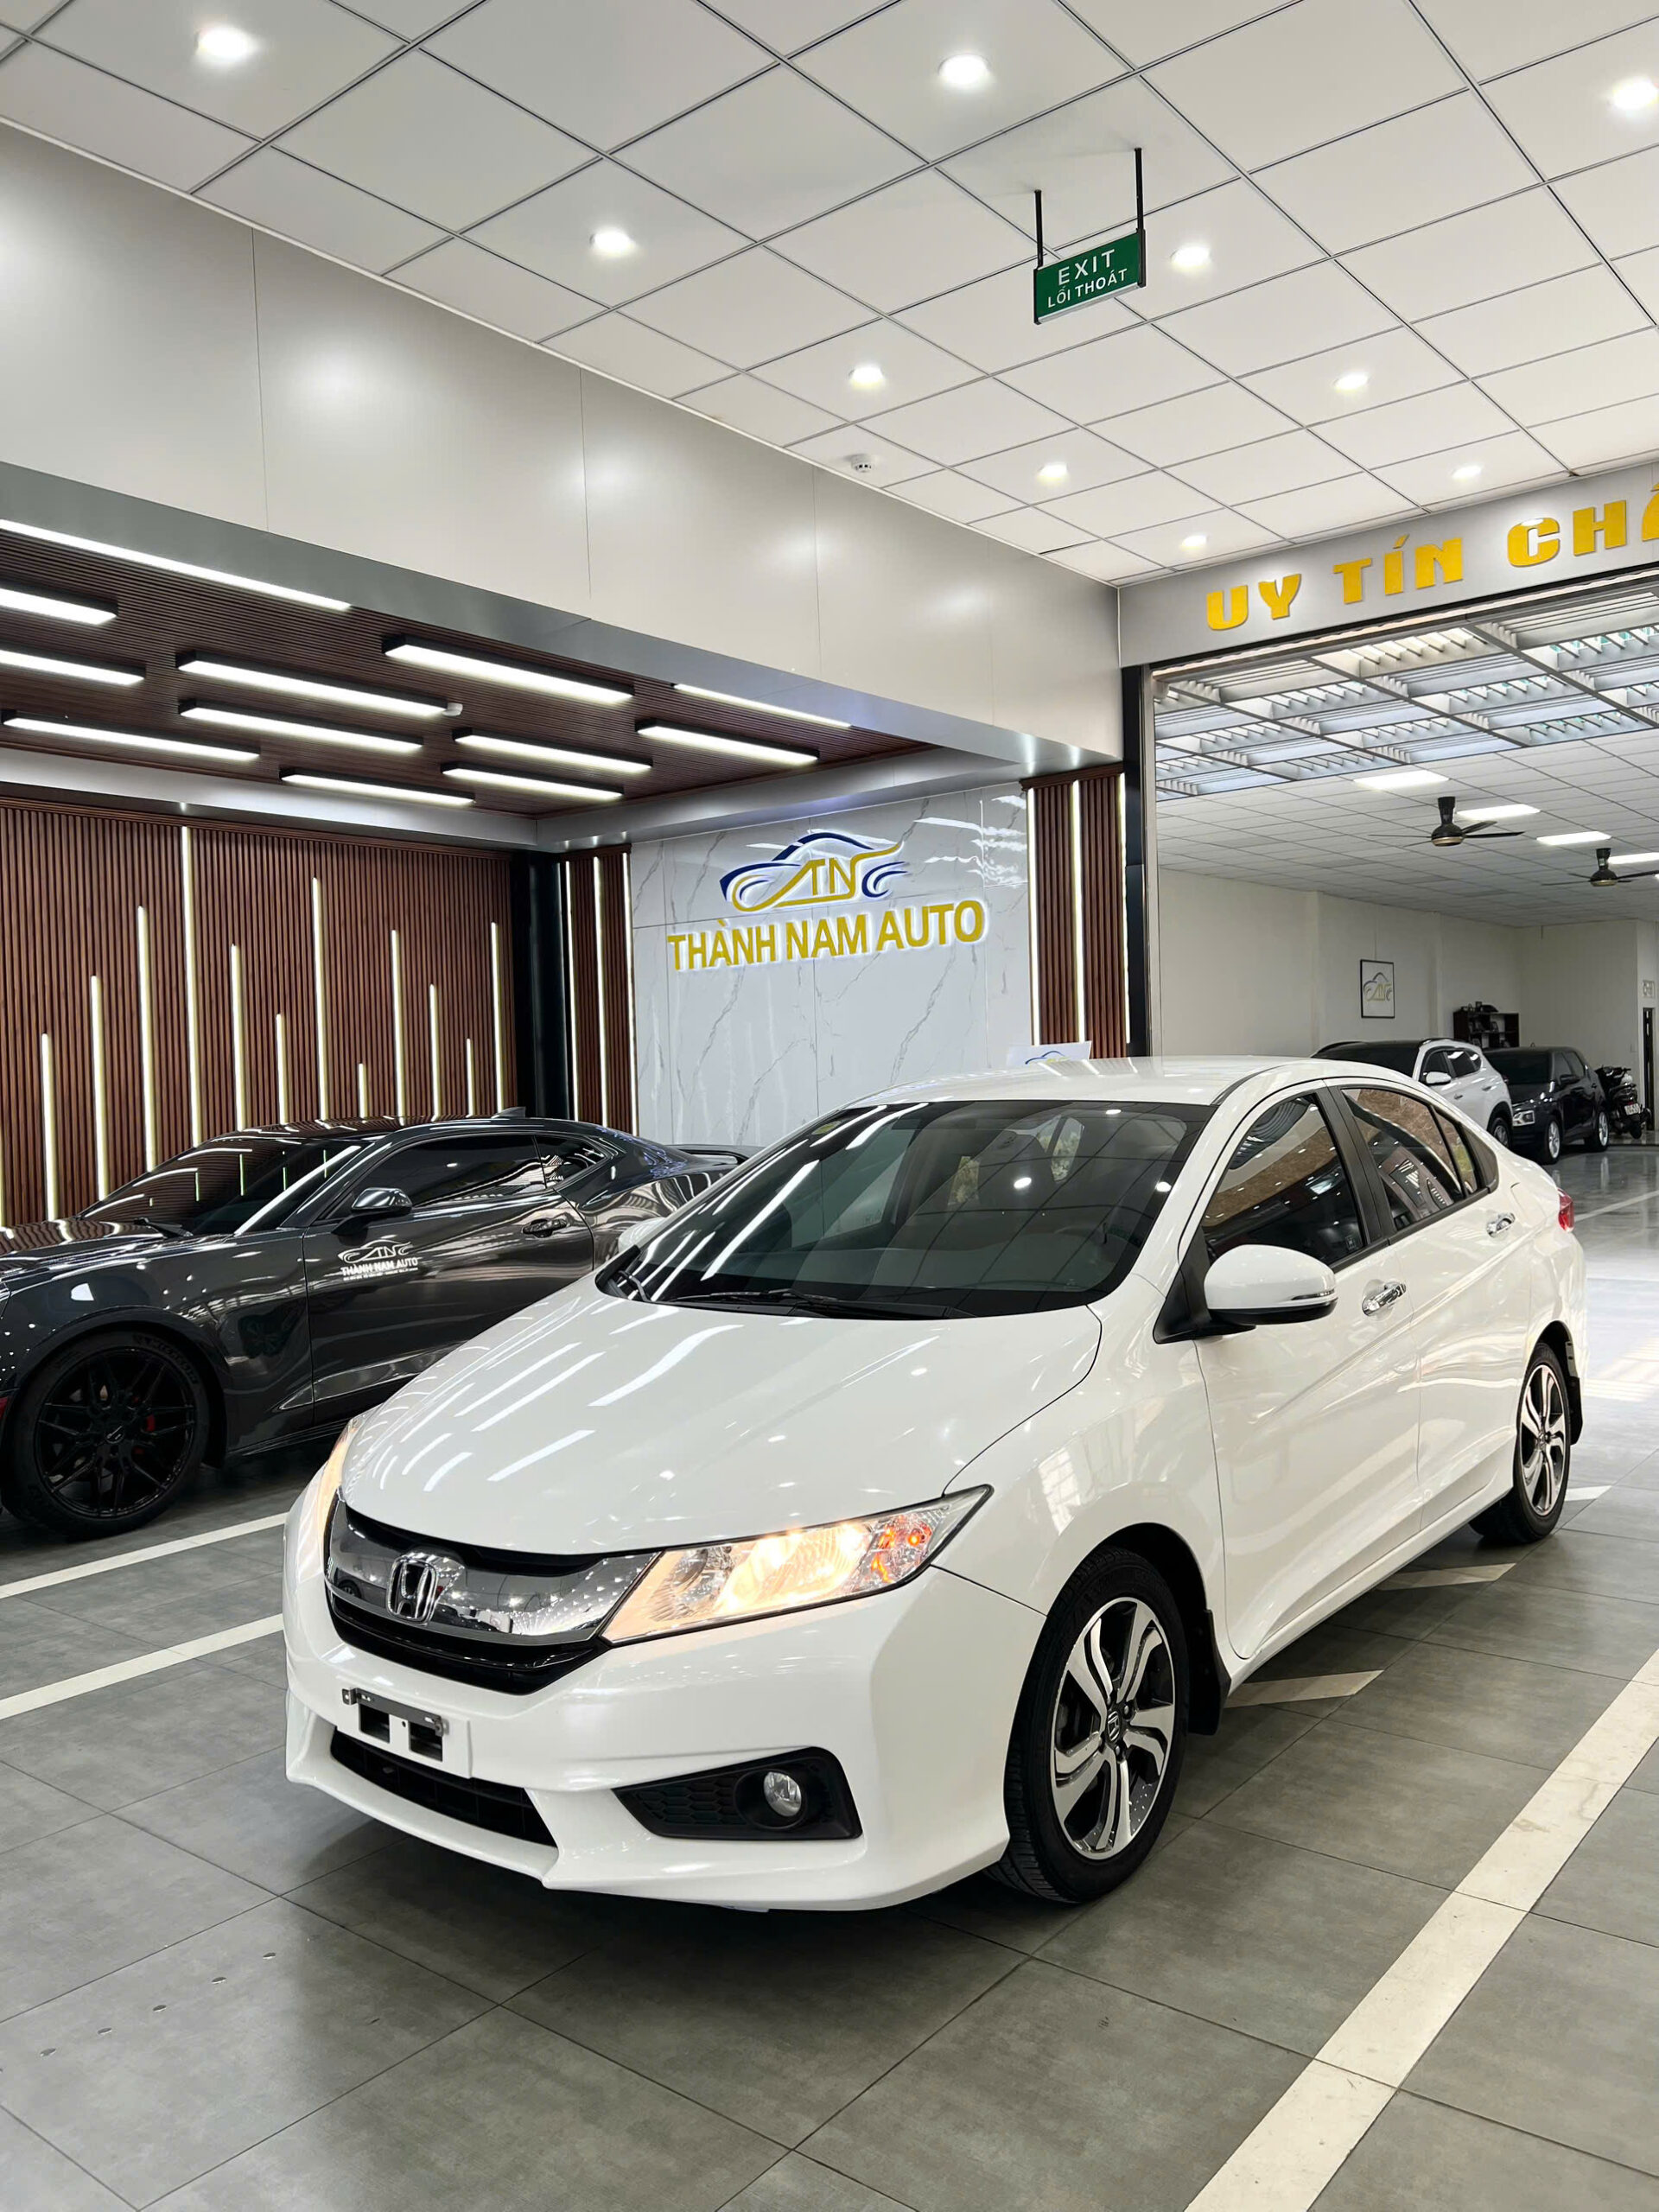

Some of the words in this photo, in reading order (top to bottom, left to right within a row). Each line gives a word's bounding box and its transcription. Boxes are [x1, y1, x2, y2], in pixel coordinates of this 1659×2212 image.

[1058, 249, 1115, 286] EXIT
[1047, 285, 1071, 308] LỐI
[1075, 269, 1128, 298] THOÁT
[1206, 574, 1301, 631] UY
[1333, 534, 1464, 604] TÍN
[667, 918, 776, 970] THÀNH
[786, 914, 867, 960] NAM
[877, 900, 983, 951] AUTO
[340, 1262, 373, 1276] THÀNH
[374, 1260, 395, 1272] NAM
[396, 1257, 418, 1269] AUTO
